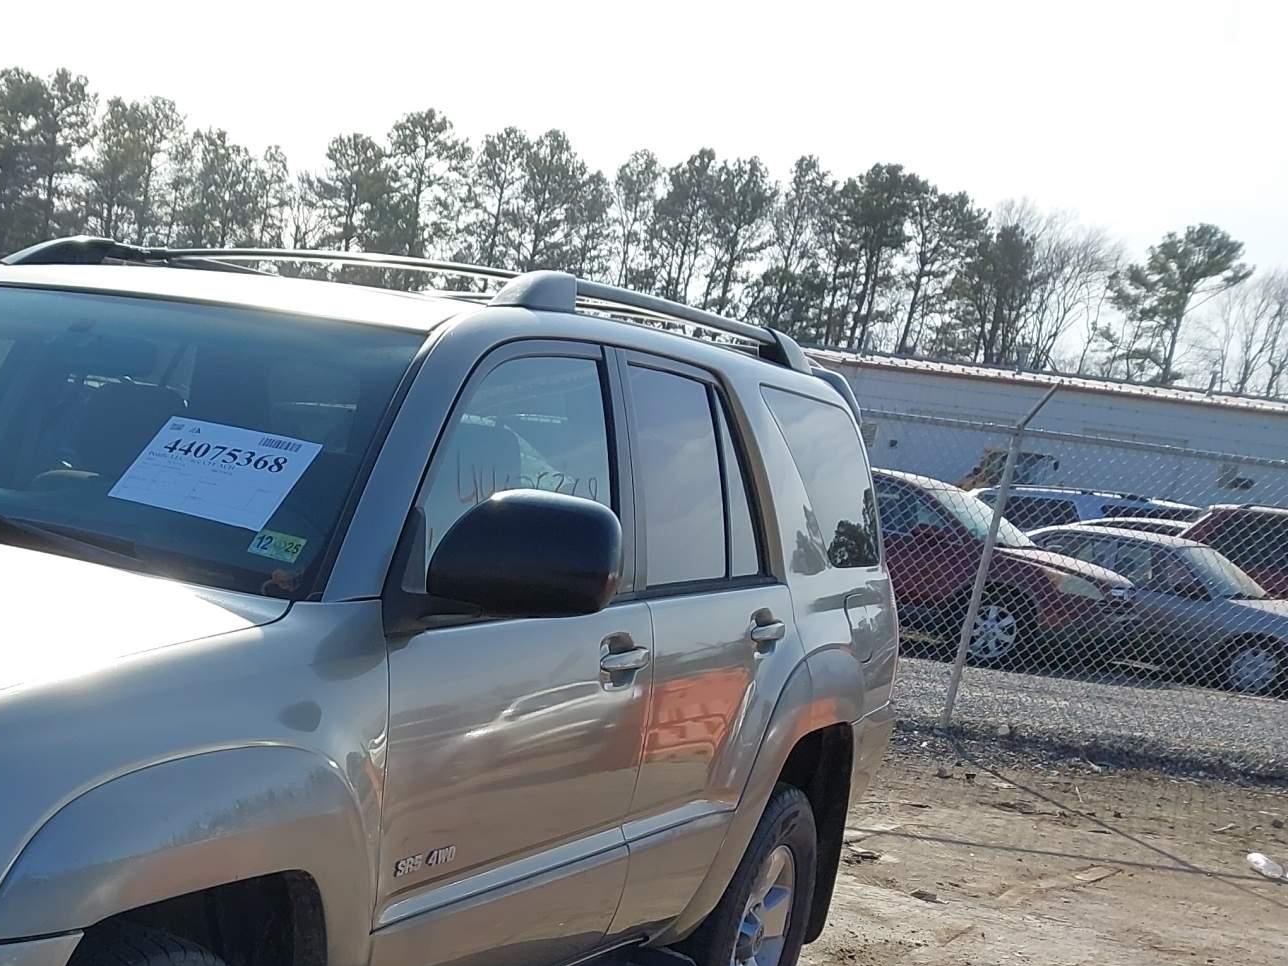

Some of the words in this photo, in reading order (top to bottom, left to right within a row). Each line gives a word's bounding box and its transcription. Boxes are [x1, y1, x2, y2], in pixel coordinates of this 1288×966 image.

[164, 438, 288, 473] 44075368
[256, 535, 273, 550] 12
[284, 543, 301, 554] 25
[393, 853, 424, 878] SR5
[425, 844, 456, 867] 4WD
